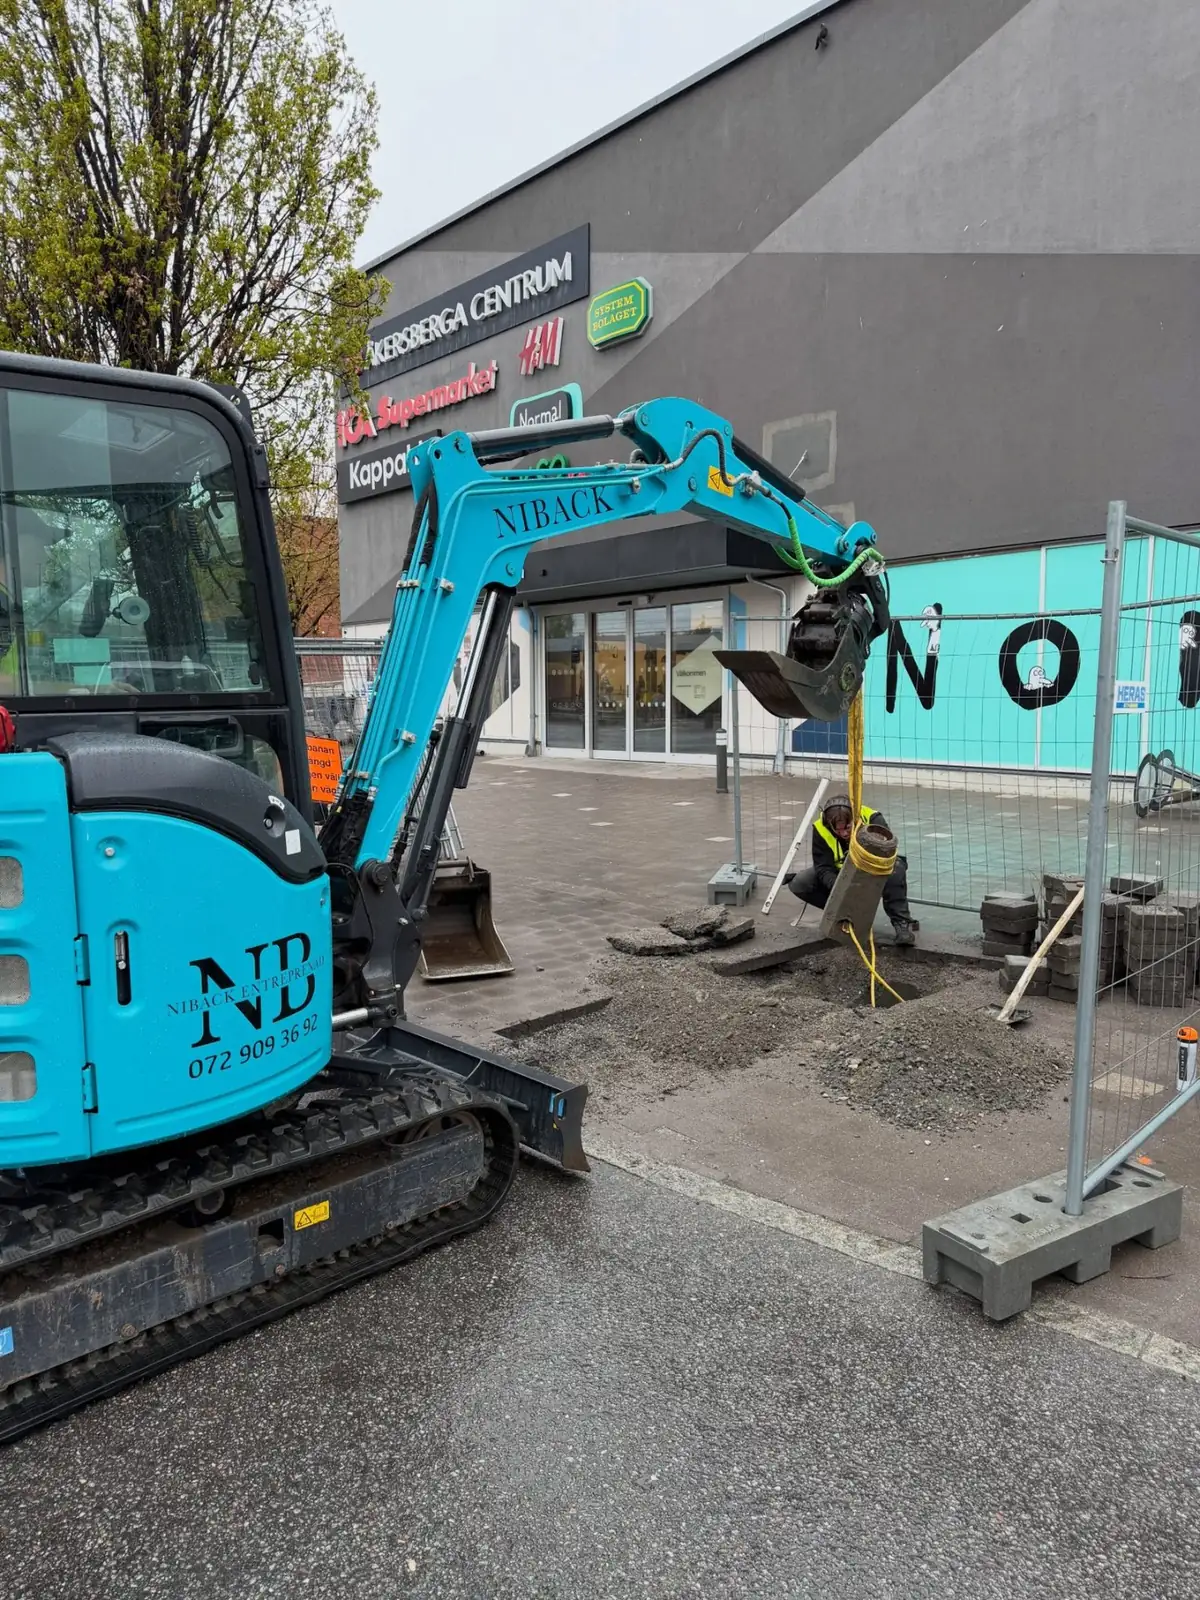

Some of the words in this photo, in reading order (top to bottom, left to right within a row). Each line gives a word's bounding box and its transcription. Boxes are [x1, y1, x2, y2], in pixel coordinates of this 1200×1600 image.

[470, 251, 573, 321] CENTRUM
[594, 295, 634, 318] SYSTEM
[593, 307, 637, 331] BOLAGET
[377, 360, 499, 430] Supermarket
[520, 400, 561, 426] Normal
[349, 440, 423, 490] Kappa
[492, 486, 614, 539] NIBACK
[1117, 685, 1146, 701] HERAS
[167, 989, 236, 1017] NIBACK
[241, 955, 325, 998] ENTREPRENAD
[188, 1050, 232, 1080] 072
[240, 1035, 275, 1065] 909
[280, 1023, 300, 1049] 36
[303, 1013, 318, 1037] 92
